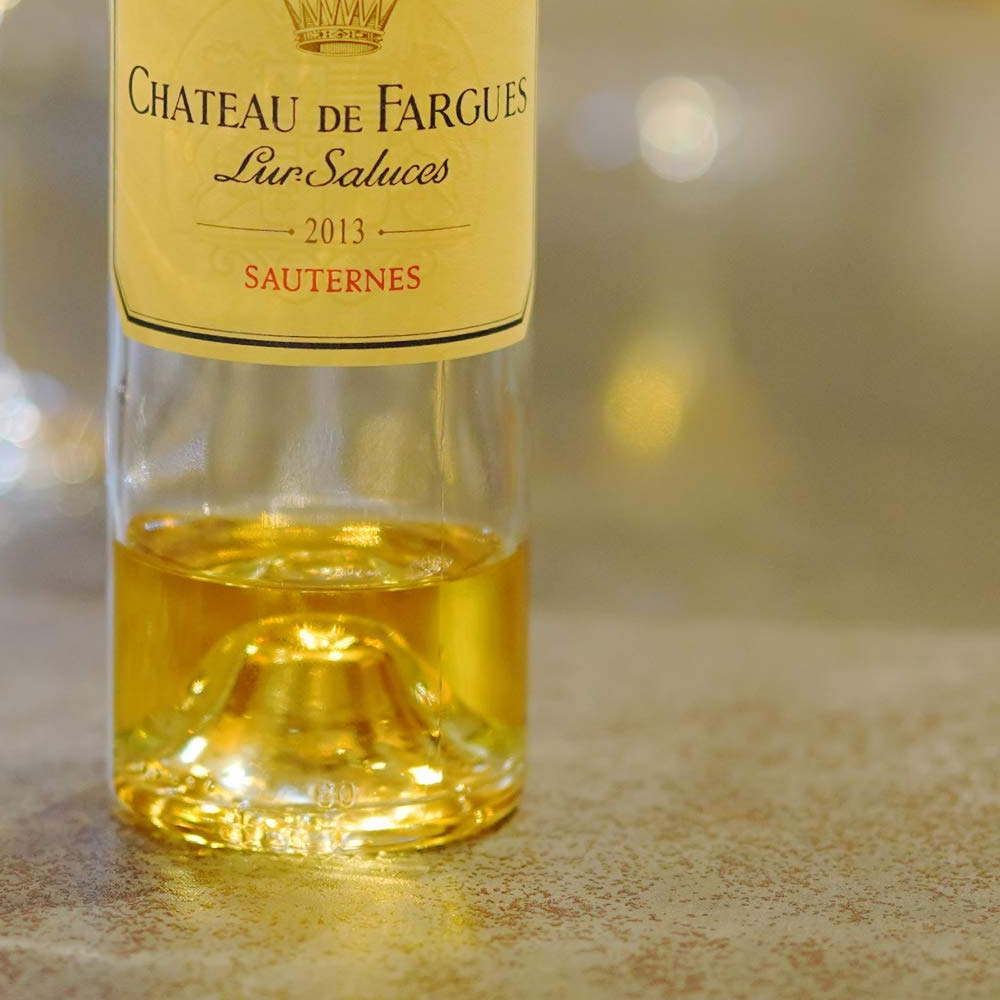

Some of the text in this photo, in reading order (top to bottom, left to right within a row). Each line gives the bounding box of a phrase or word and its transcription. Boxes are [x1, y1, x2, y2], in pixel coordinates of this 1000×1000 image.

[128, 65, 529, 134] CHATEAU DE FARGUES
[304, 217, 365, 245] 2013
[244, 264, 422, 294] SAUTERNES
